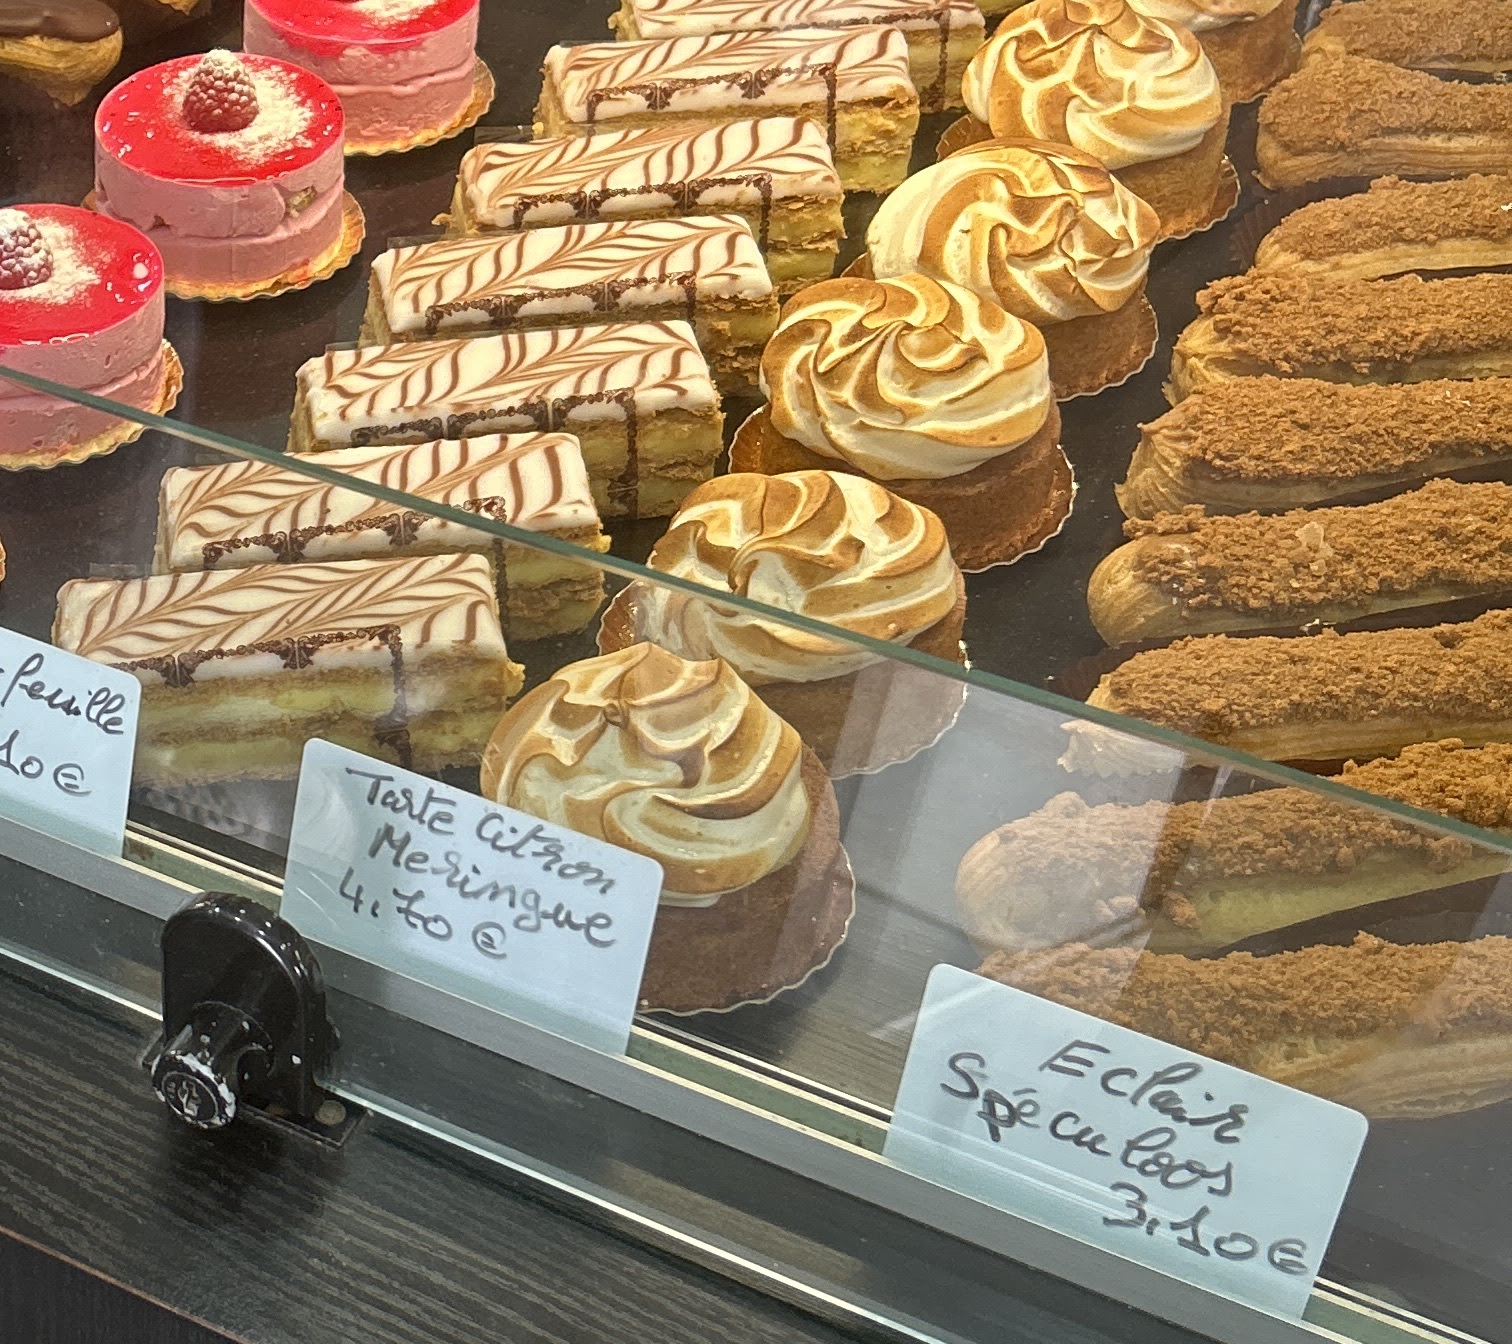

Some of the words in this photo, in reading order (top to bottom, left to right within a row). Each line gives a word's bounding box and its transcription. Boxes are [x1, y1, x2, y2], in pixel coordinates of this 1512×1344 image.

[345, 766, 457, 836] Tarte
[476, 811, 616, 895] Citron
[368, 822, 616, 948] Meringue
[1038, 1039, 1250, 1144] Eclair
